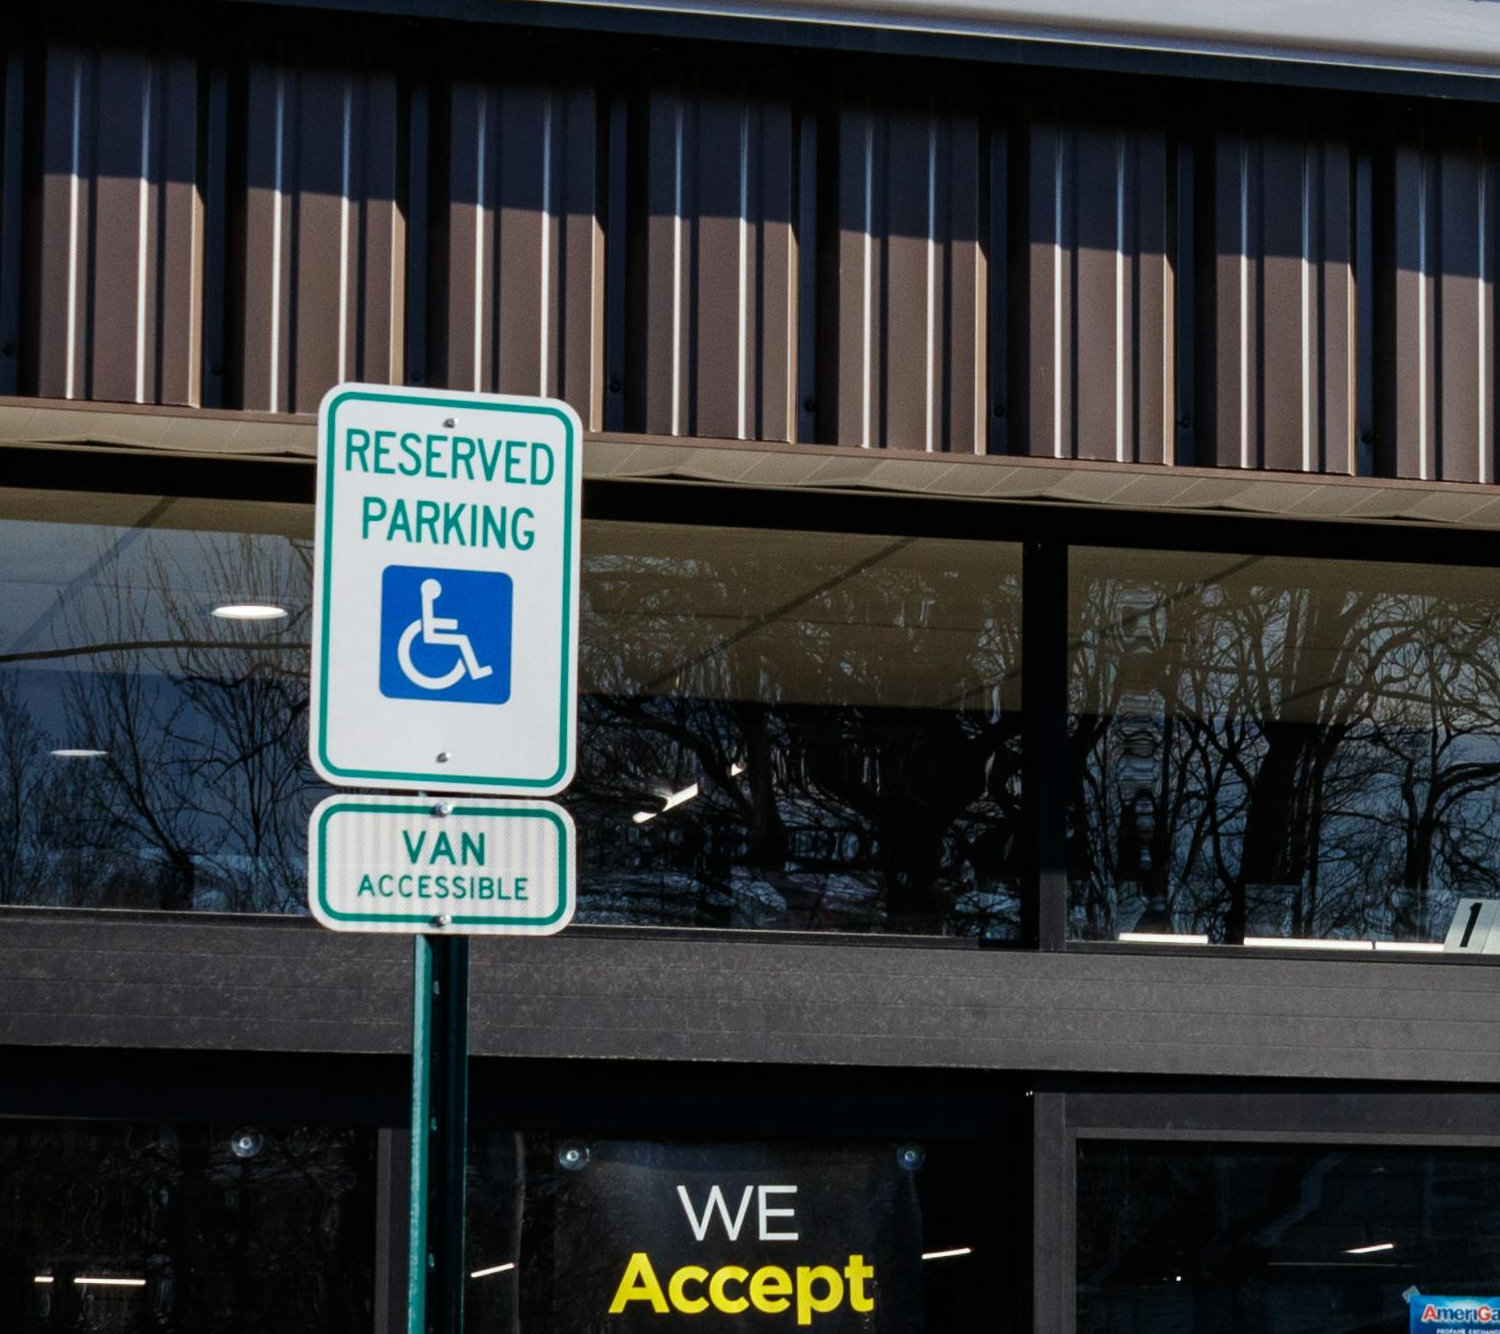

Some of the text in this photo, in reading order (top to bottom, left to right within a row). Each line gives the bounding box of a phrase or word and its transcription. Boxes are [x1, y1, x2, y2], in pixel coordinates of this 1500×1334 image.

[345, 428, 554, 486] RESERVED
[362, 496, 535, 551] PARKING
[402, 830, 485, 866] VAN
[357, 874, 529, 900] ACCESSIBLE
[677, 1185, 799, 1241] WE
[608, 1252, 874, 1325] Accept
